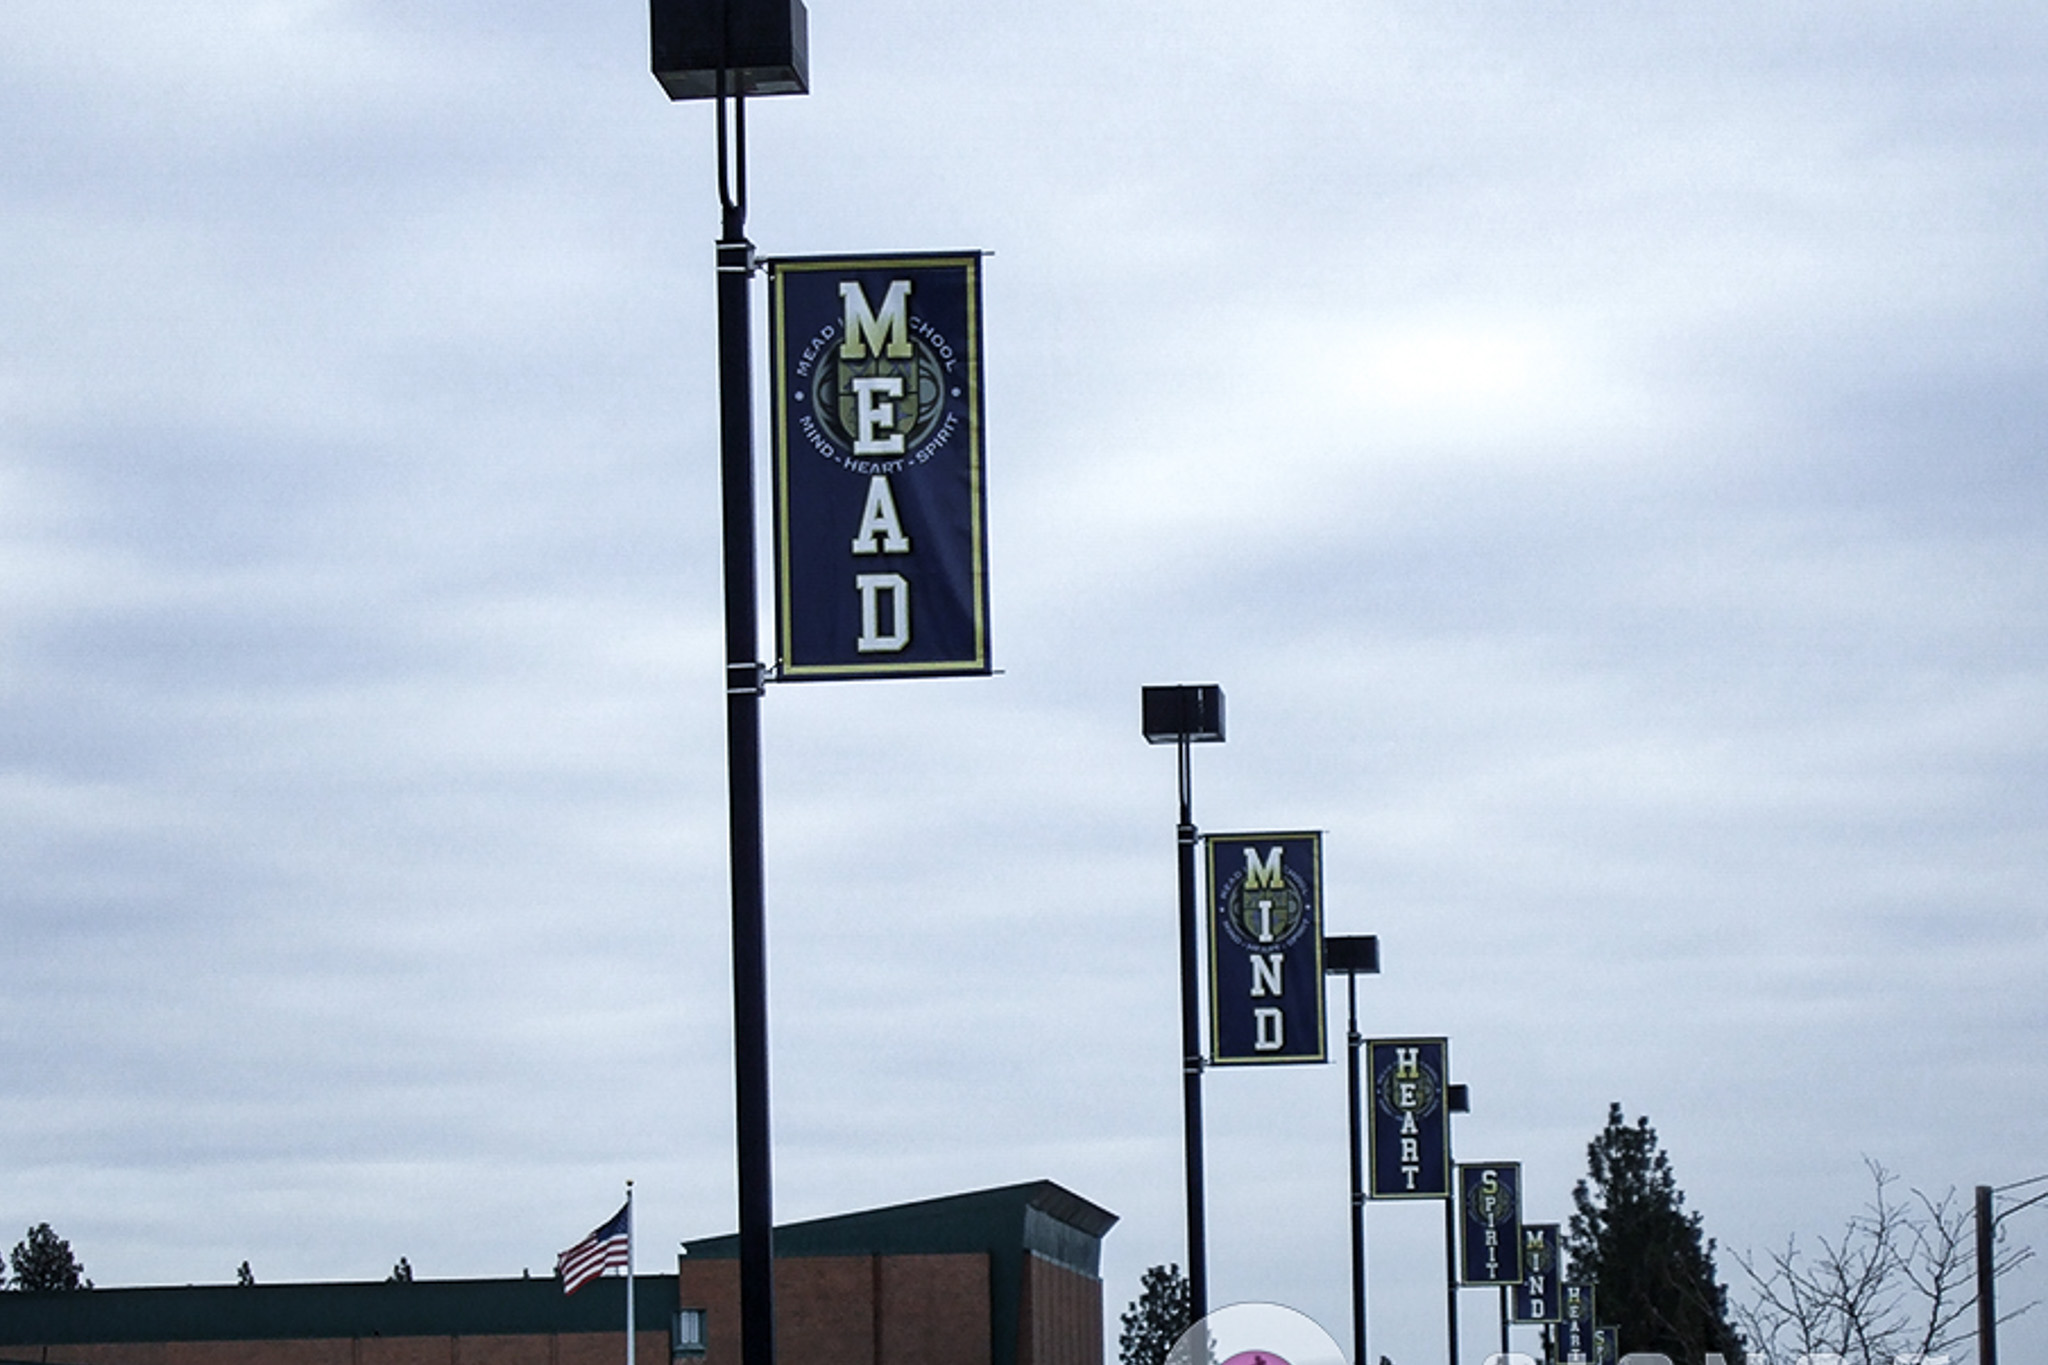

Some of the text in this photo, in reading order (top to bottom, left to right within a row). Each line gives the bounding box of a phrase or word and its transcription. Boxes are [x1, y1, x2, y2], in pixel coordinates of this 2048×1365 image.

[796, 315, 958, 377] MEAD CHOOL
[800, 412, 959, 475] MIND HEART SPIRIT
[838, 279, 913, 653] MEAD
[1243, 846, 1284, 1051] MIND
[1395, 1047, 1420, 1190] HEART
[1481, 1170, 1499, 1280] SPIRIT
[1526, 1230, 1545, 1319] MIND
